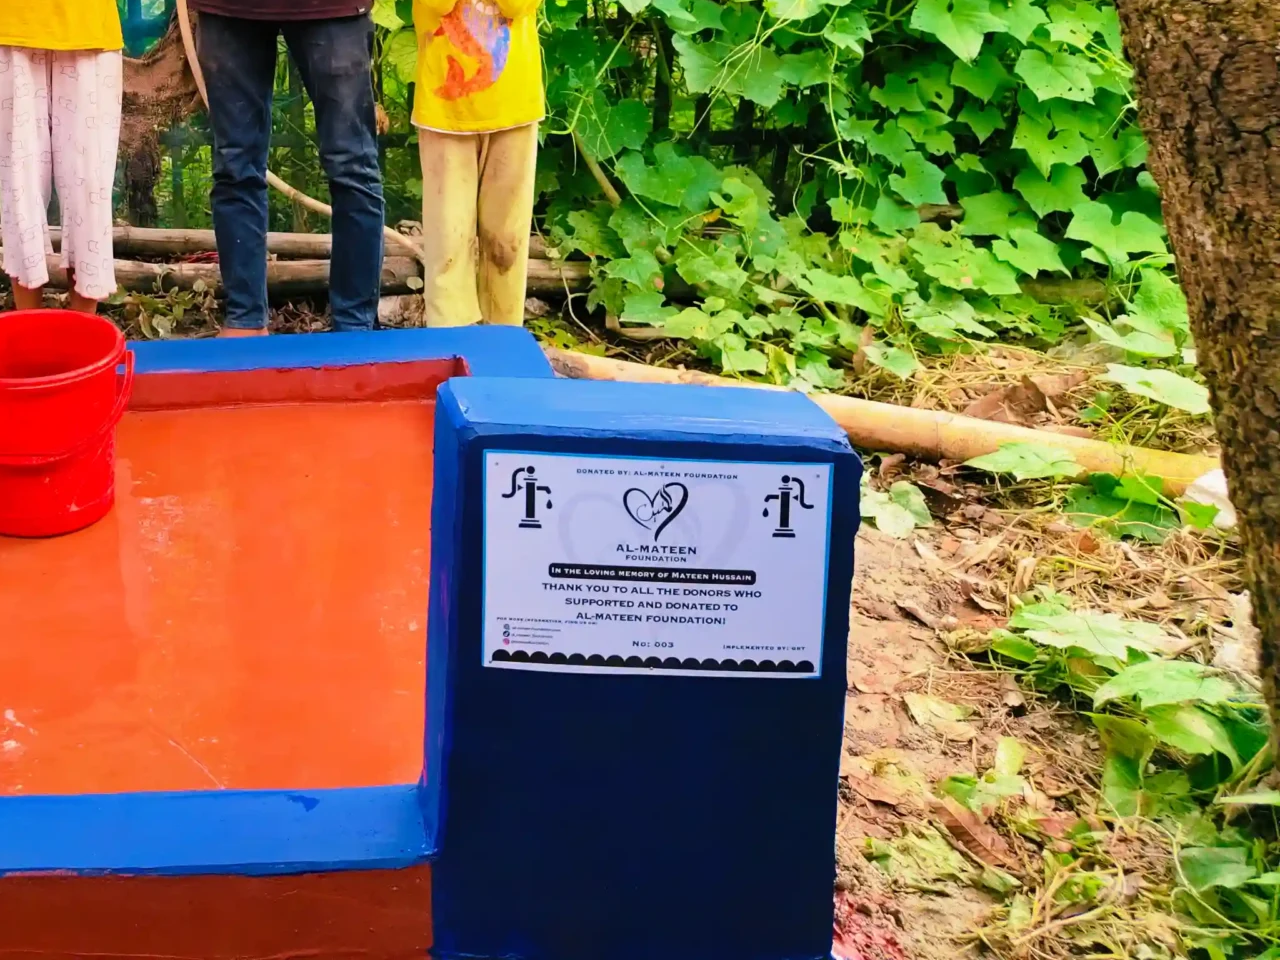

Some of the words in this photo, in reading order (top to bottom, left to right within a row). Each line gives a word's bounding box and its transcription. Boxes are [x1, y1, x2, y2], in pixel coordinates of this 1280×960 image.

[633, 470, 681, 478] AL-MATEEN
[684, 472, 738, 480] FOUNDATION
[616, 544, 697, 555] AL-MATEEN
[625, 554, 687, 563] FOUNDATION
[618, 570, 655, 578] MEMORY
[542, 582, 583, 592] THANK
[585, 584, 610, 593] YOU
[613, 585, 628, 593] TO
[630, 586, 654, 595] ALL
[657, 587, 680, 596] THE
[683, 588, 732, 598] DONORS
[734, 590, 762, 598] WHO
[565, 597, 635, 608] SUPPORTED
[637, 600, 663, 609] AND
[665, 601, 720, 611] DONATED
[723, 603, 738, 611] TO
[576, 612, 642, 622] AL-MATEEN
[646, 615, 726, 625] FOUNDATION!
